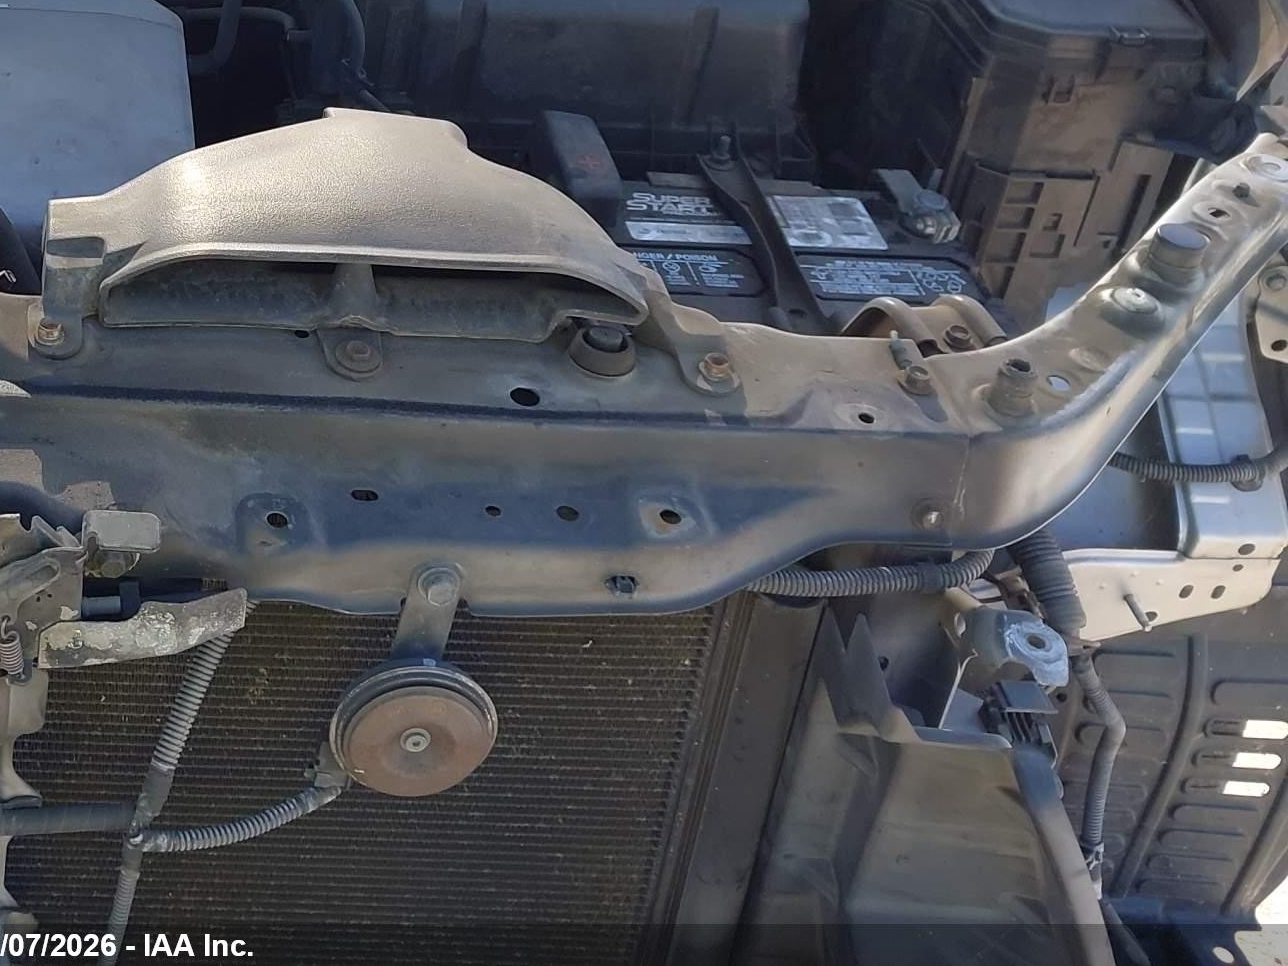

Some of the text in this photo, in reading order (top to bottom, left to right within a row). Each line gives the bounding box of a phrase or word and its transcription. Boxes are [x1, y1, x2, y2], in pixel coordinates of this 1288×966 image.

[631, 192, 711, 205] SUPER
[626, 200, 714, 214] START
[631, 251, 666, 260] NGER
[675, 253, 718, 261] POISON
